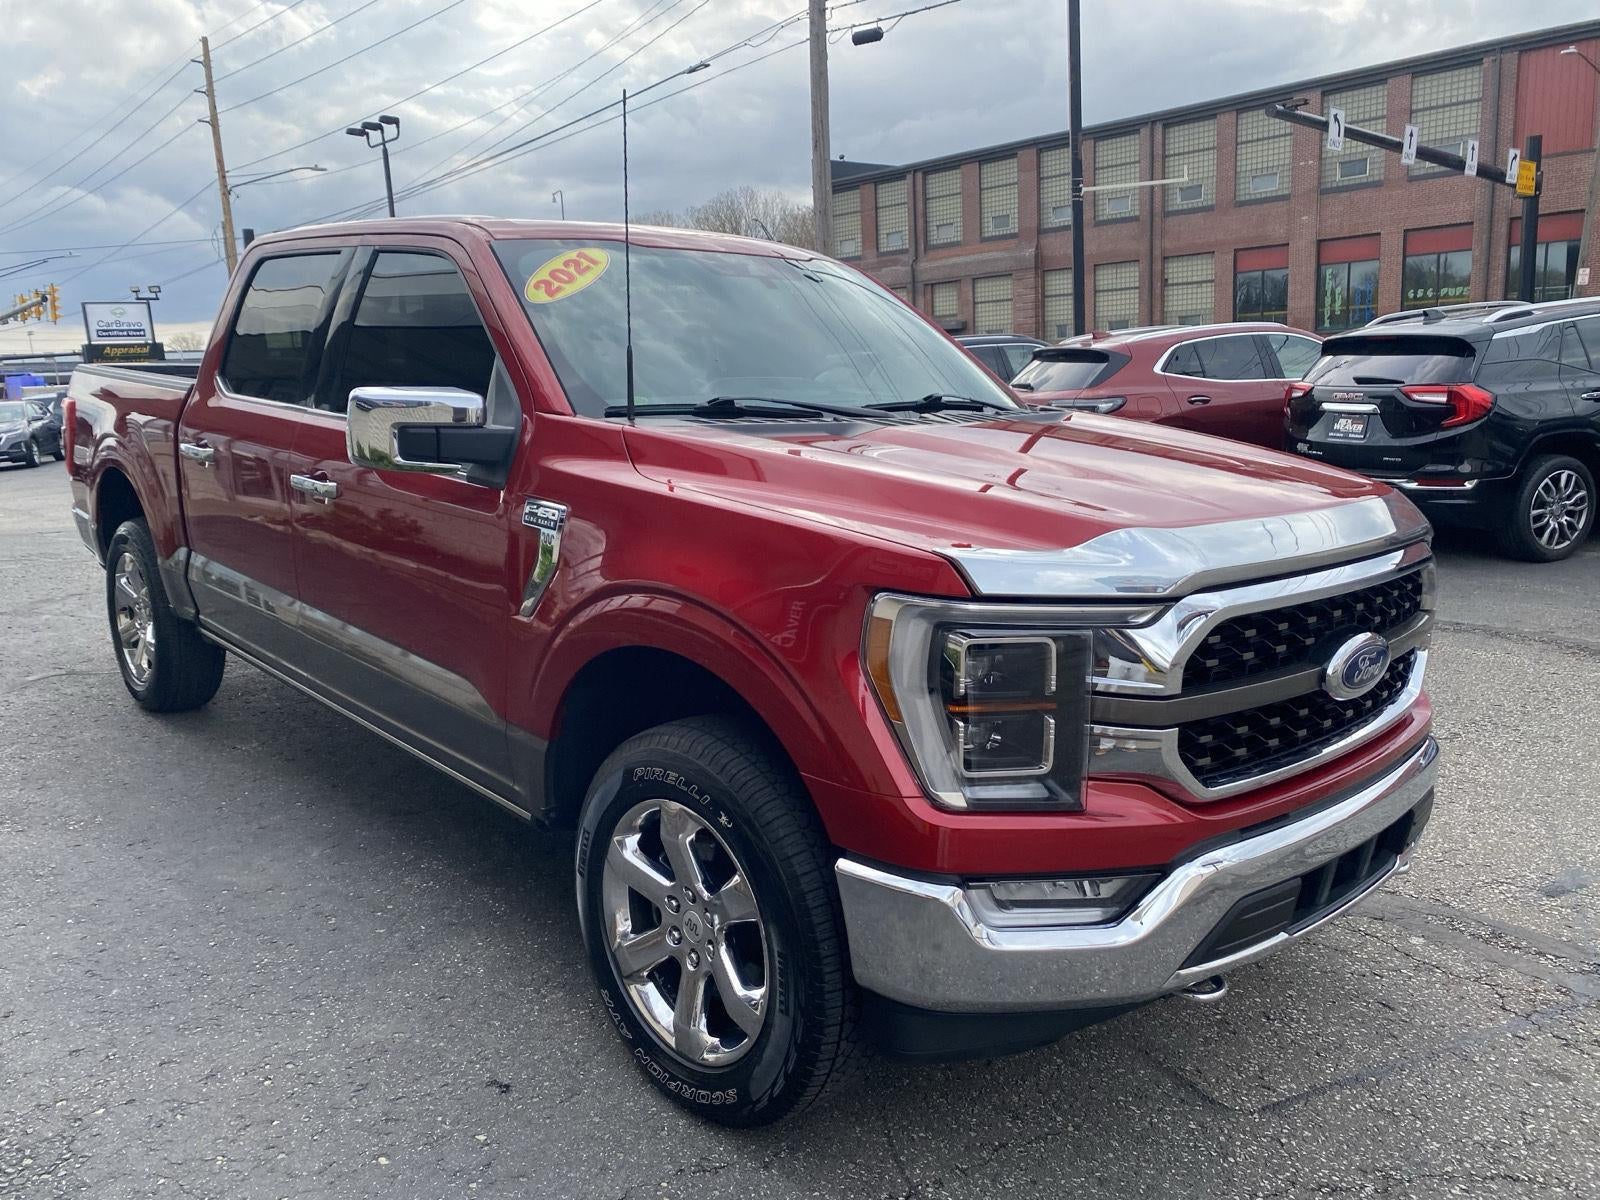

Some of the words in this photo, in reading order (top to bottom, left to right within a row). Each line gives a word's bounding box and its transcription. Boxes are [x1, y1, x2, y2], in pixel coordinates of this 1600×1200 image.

[1329, 137, 1342, 149] ONLY
[533, 251, 600, 298] 2021
[97, 320, 143, 328] CarBravo
[103, 346, 149, 356] Appraisal
[1333, 392, 1364, 401] GMC
[1334, 422, 1364, 433] WEAVER
[1354, 651, 1383, 683] Ford
[633, 767, 711, 805] PIRELLI
[634, 1047, 738, 1105] SCORPION
